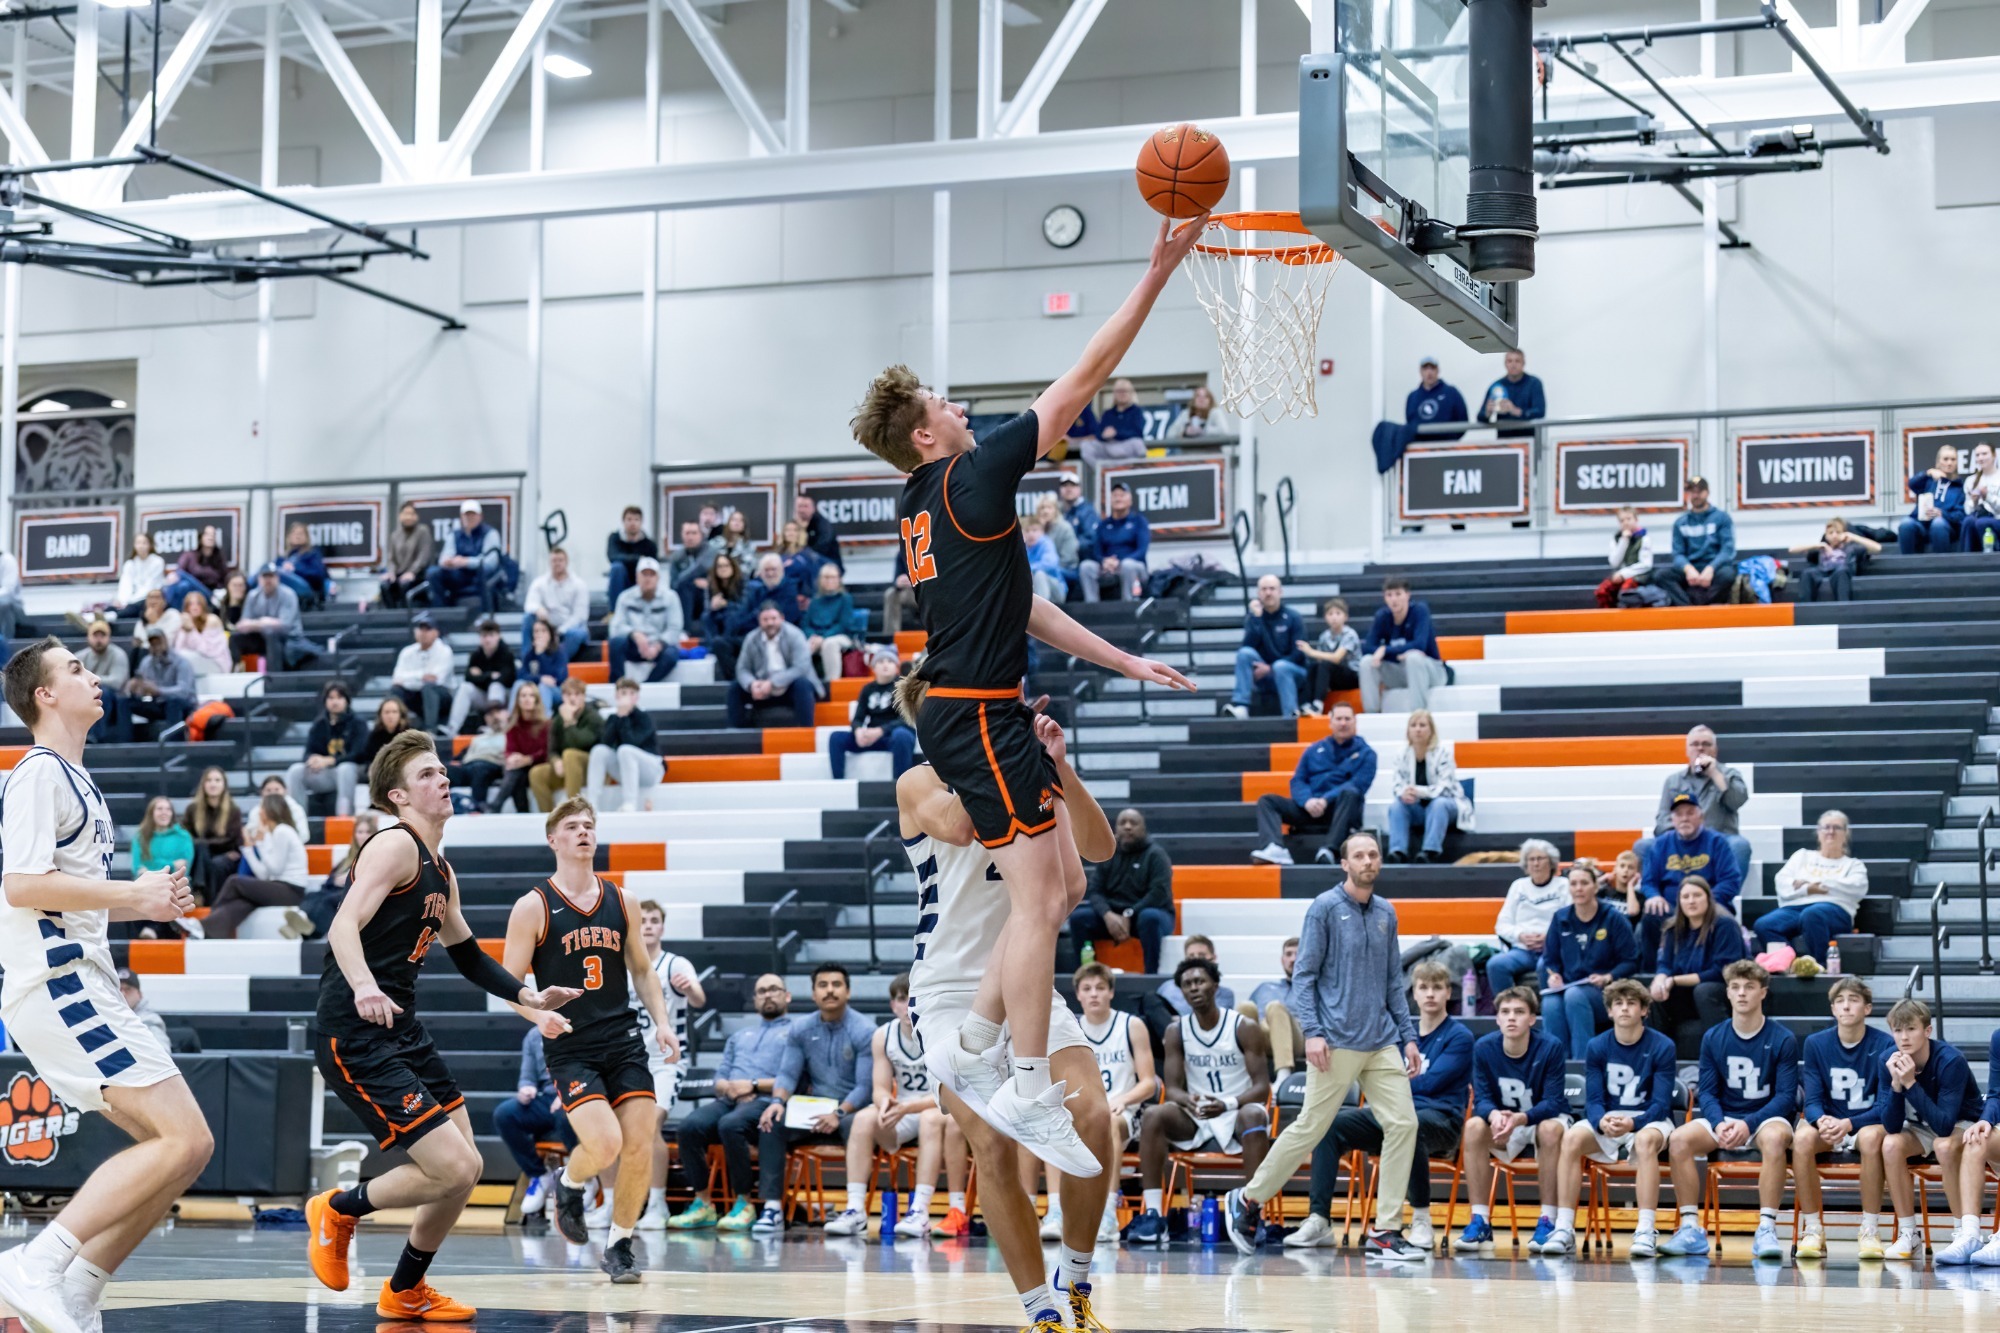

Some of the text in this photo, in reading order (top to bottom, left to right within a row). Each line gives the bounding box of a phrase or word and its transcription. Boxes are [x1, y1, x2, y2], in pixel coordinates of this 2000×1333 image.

[1443, 469, 1482, 495] FAN
[1577, 463, 1666, 490] SECTION
[1758, 456, 1854, 484] VISITING
[817, 498, 896, 523] SECTION
[1135, 485, 1189, 511] TEAM
[45, 533, 91, 559] BAND
[900, 510, 938, 587] 12
[561, 926, 621, 956] TIGERS
[583, 955, 603, 990] 3
[902, 1071, 929, 1092] 22
[1206, 1070, 1223, 1093] 11
[1606, 1062, 1648, 1106] PL
[1726, 1055, 1771, 1100] PL
[1829, 1067, 1876, 1110] PL
[0, 1112, 80, 1149] IGERS
